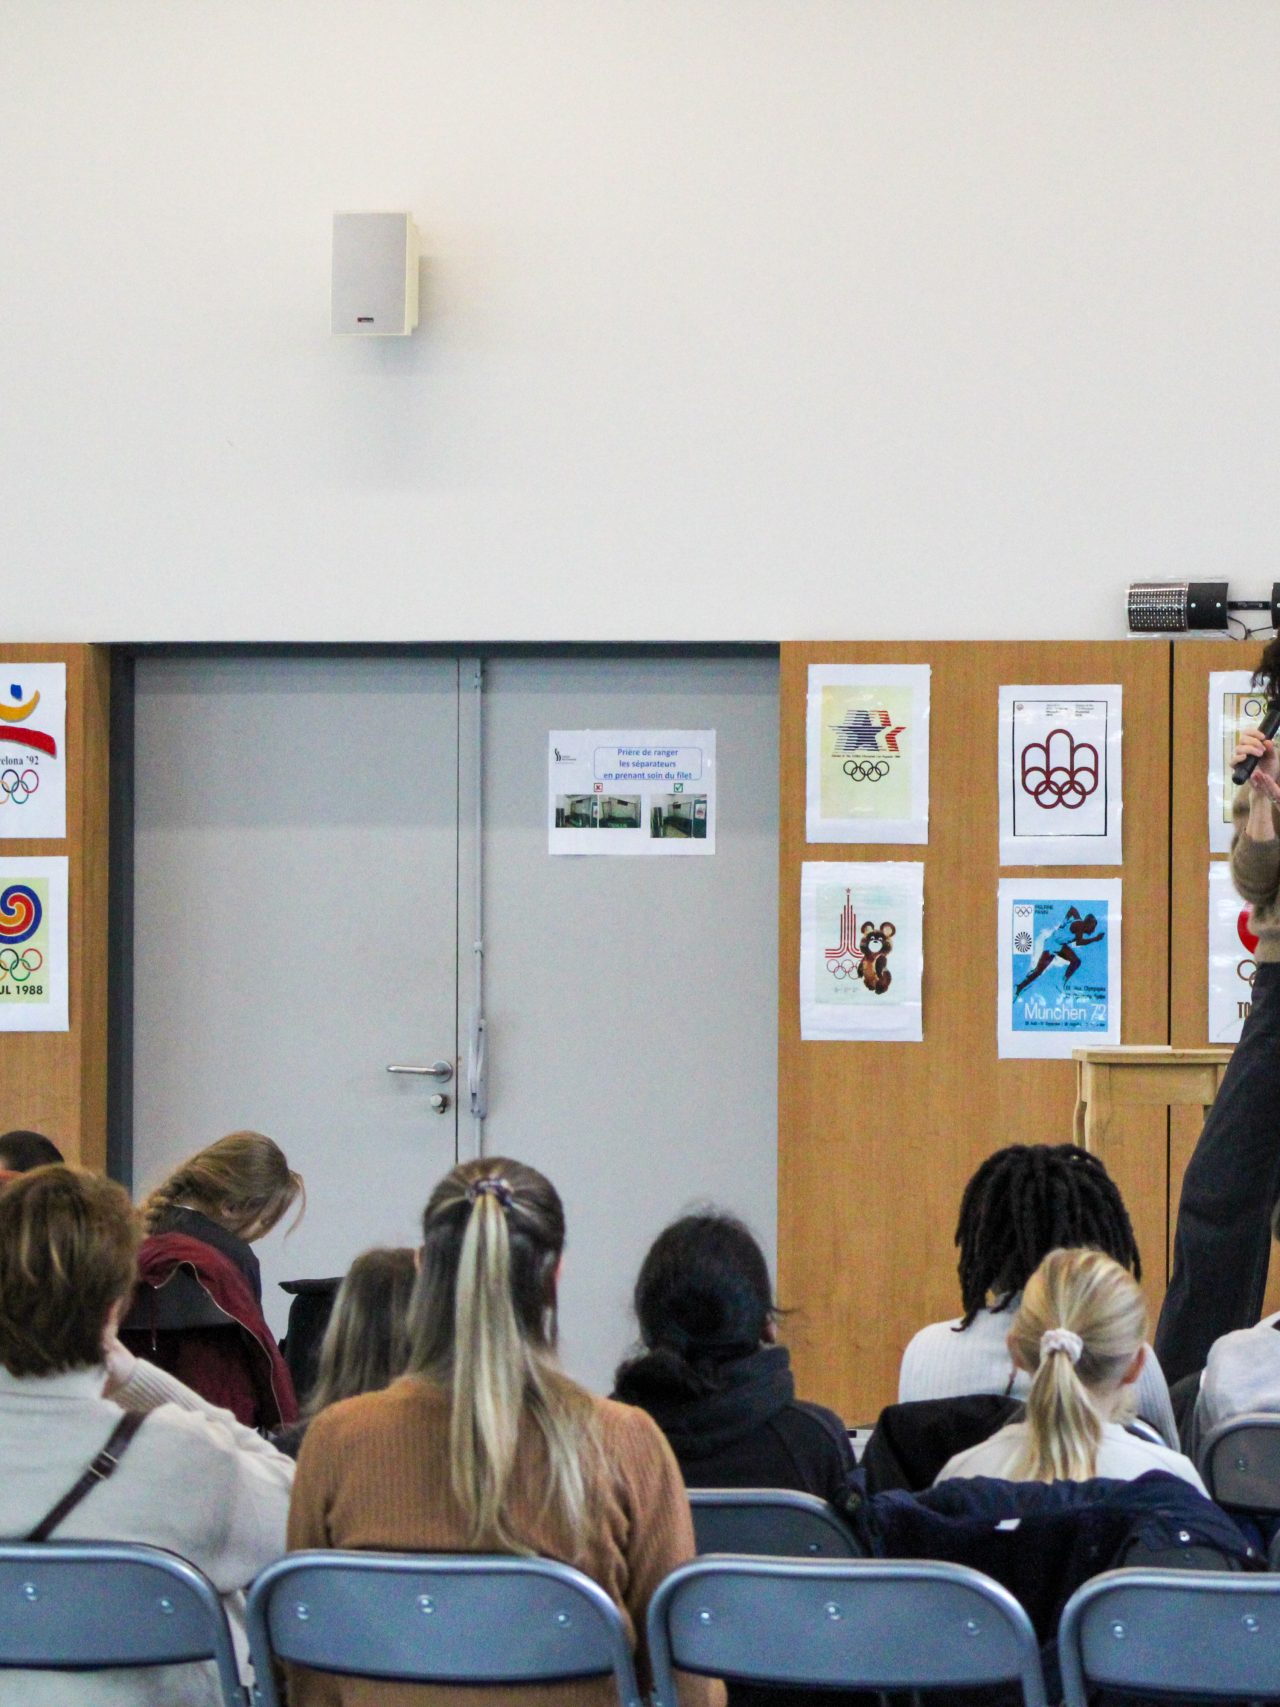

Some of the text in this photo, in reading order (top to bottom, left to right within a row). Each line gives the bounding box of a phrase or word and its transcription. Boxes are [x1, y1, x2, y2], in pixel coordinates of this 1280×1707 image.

[642, 748, 652, 756] de
[619, 760, 676, 769] les séparateurs
[615, 772, 645, 780] prenant
[677, 771, 692, 780] filet
[16, 985, 43, 995] 1988
